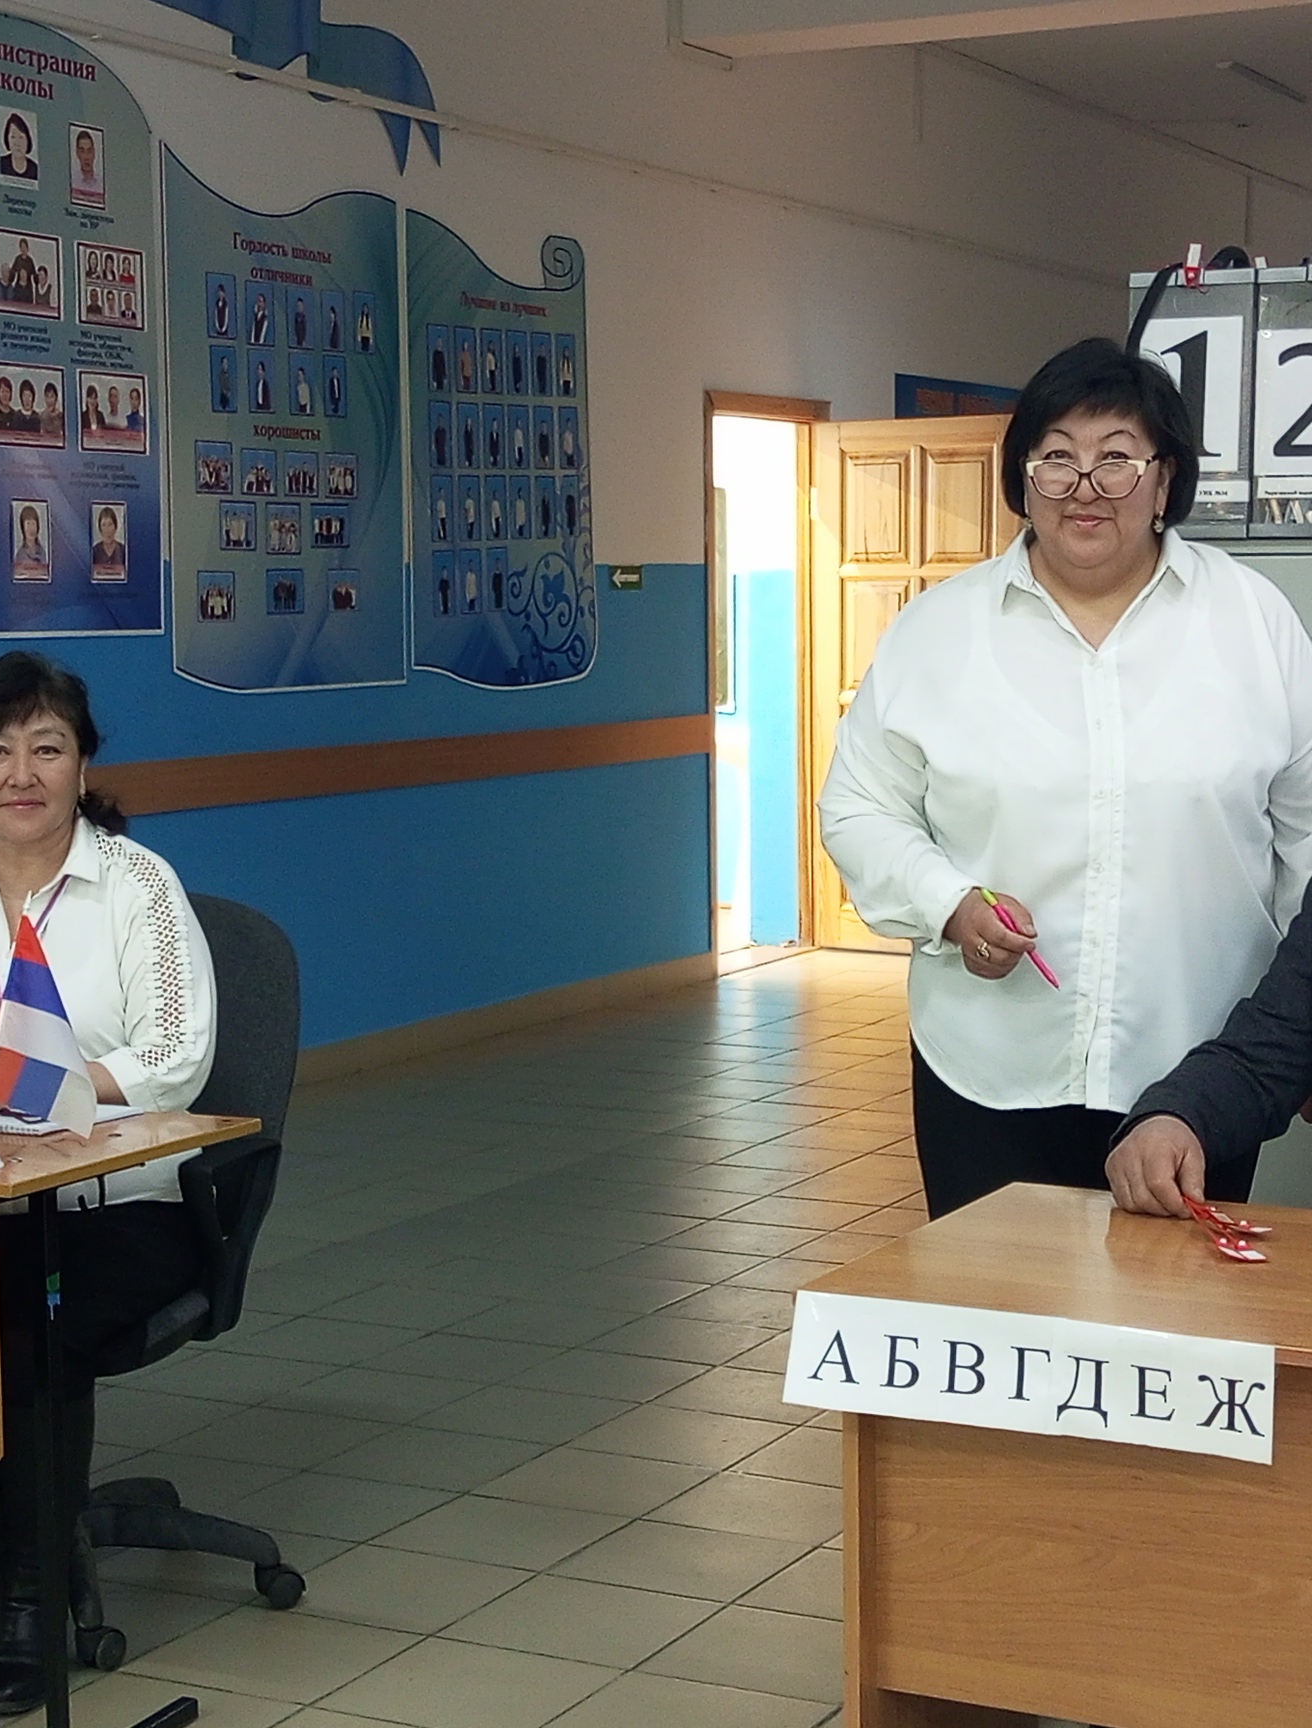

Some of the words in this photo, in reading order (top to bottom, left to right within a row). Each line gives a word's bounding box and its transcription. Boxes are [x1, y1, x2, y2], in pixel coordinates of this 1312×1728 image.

[233, 231, 288, 257] Гордость
[291, 243, 332, 264] школы
[250, 266, 313, 287] отличники
[1160, 330, 1222, 457] 1
[253, 424, 321, 441] хорошисты
